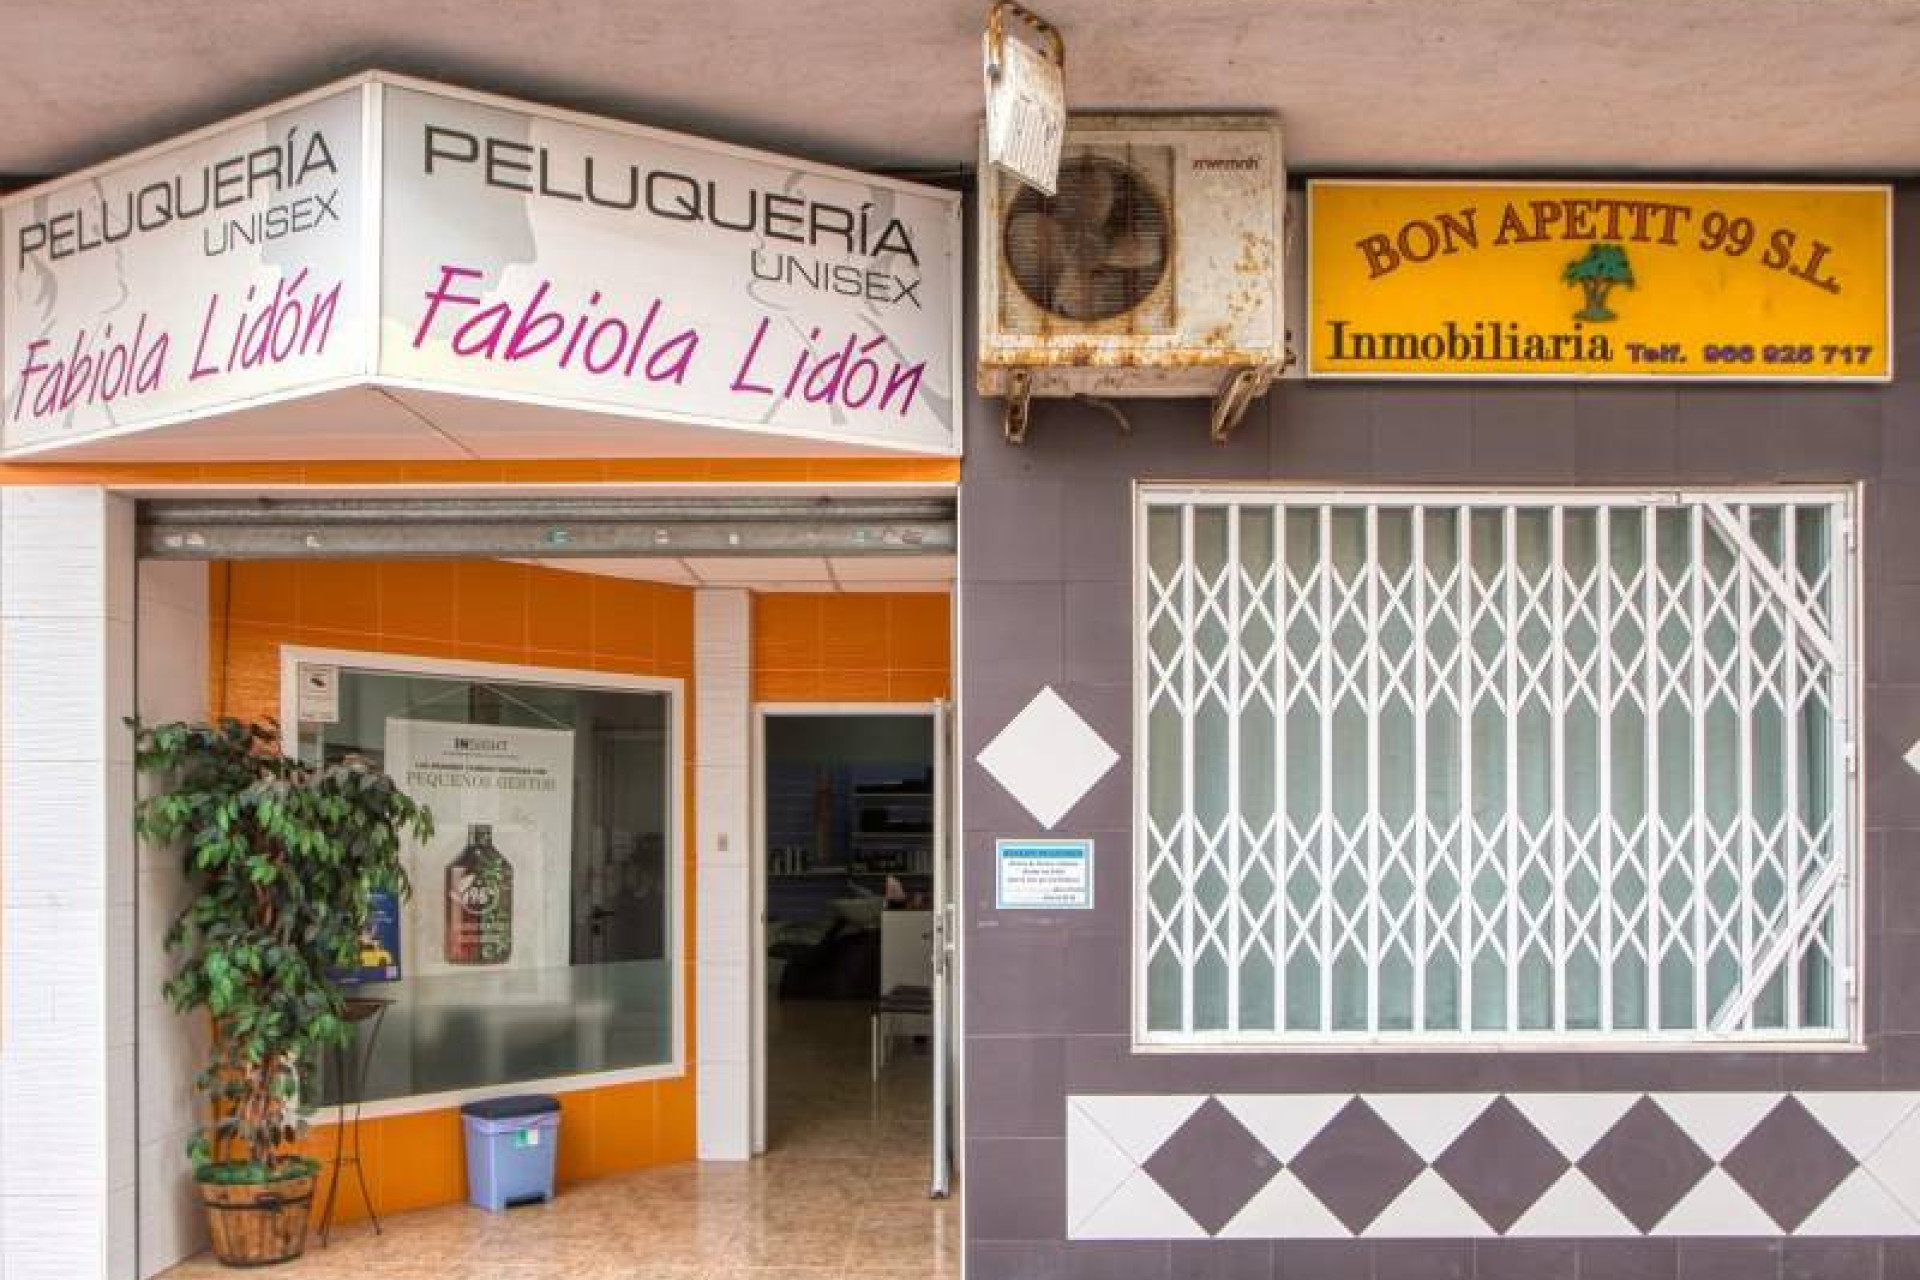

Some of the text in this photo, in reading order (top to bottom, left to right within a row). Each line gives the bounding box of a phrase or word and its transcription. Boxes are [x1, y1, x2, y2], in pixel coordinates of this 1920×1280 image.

[19, 126, 337, 270] PELUQUERÍA
[204, 189, 339, 256] UNISEX
[424, 124, 919, 266] PELUQUERÍA
[750, 249, 922, 309] UNISEX
[1356, 208, 1479, 279] BON
[1494, 198, 1691, 246] APETIT
[1700, 210, 1755, 257] 99
[14, 267, 342, 421] Fabiola Lidón
[413, 265, 926, 416] Fabiola Lidón
[1327, 320, 1613, 361] Inmobiliaria
[1820, 344, 1873, 364] 717
